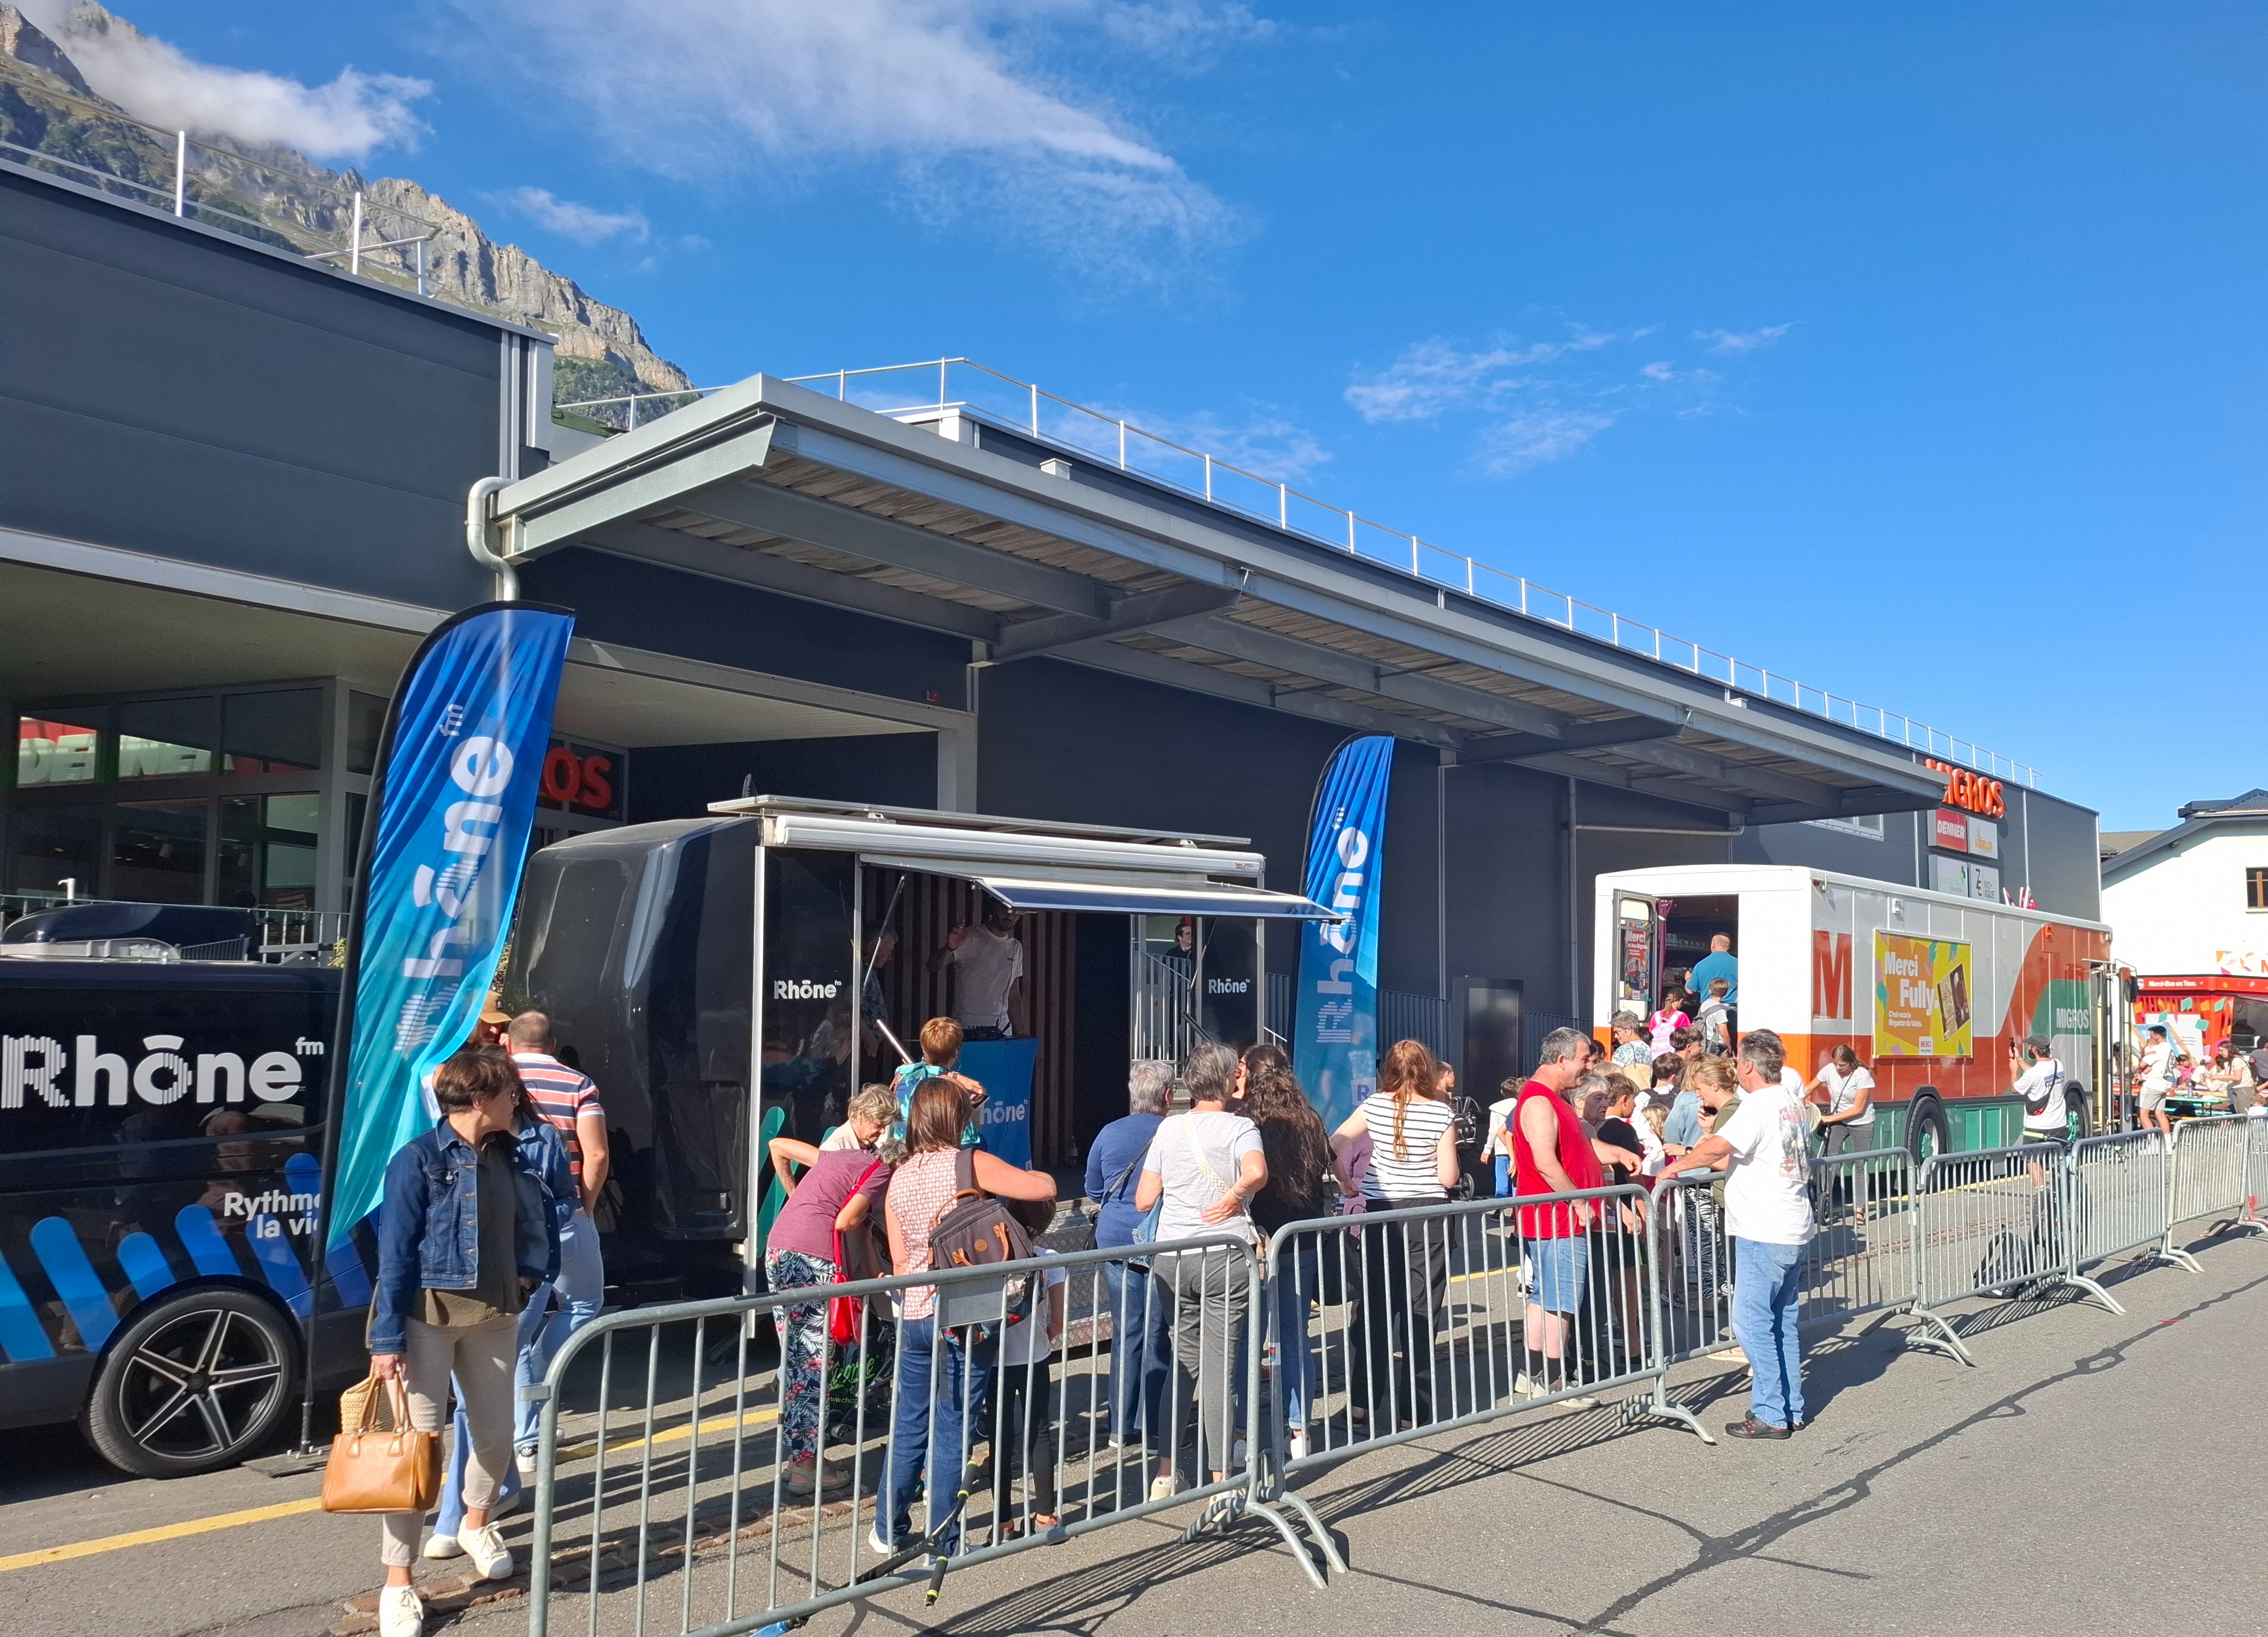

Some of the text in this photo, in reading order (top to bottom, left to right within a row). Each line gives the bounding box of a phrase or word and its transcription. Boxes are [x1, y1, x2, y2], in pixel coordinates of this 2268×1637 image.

[439, 704, 464, 737] fm
[1937, 820, 1965, 839] DENNER
[1626, 930, 1646, 943] Merci
[1813, 930, 1852, 1020] M
[1885, 951, 1918, 977] Merci
[1900, 979, 1939, 1015] Fully.
[2057, 1008, 2089, 1029] MIGROS
[295, 1037, 324, 1055] fm
[979, 1101, 1025, 1125] hône
[257, 1214, 280, 1238] la
